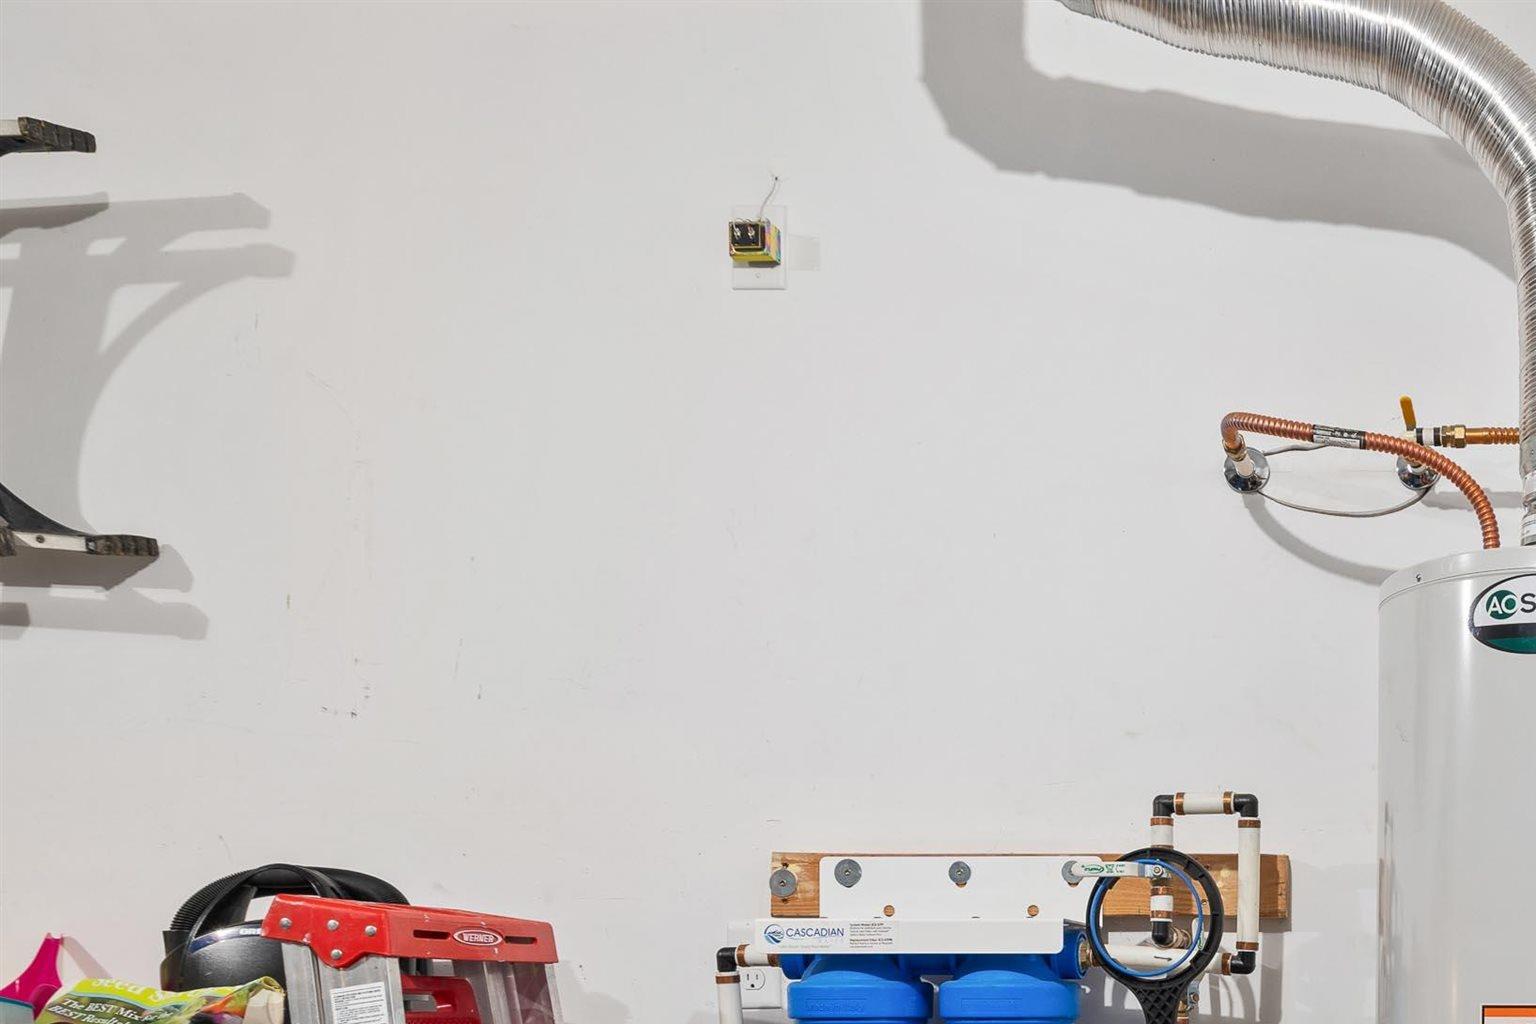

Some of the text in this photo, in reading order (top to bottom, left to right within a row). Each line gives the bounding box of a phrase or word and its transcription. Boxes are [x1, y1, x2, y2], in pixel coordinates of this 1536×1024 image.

[463, 933, 494, 943] WERNER
[785, 927, 845, 938] CASCADIAN
[48, 1005, 86, 1021] BEST
[61, 998, 85, 1010] The
[85, 1002, 117, 1014] BEST
[116, 1007, 141, 1021] Mix
